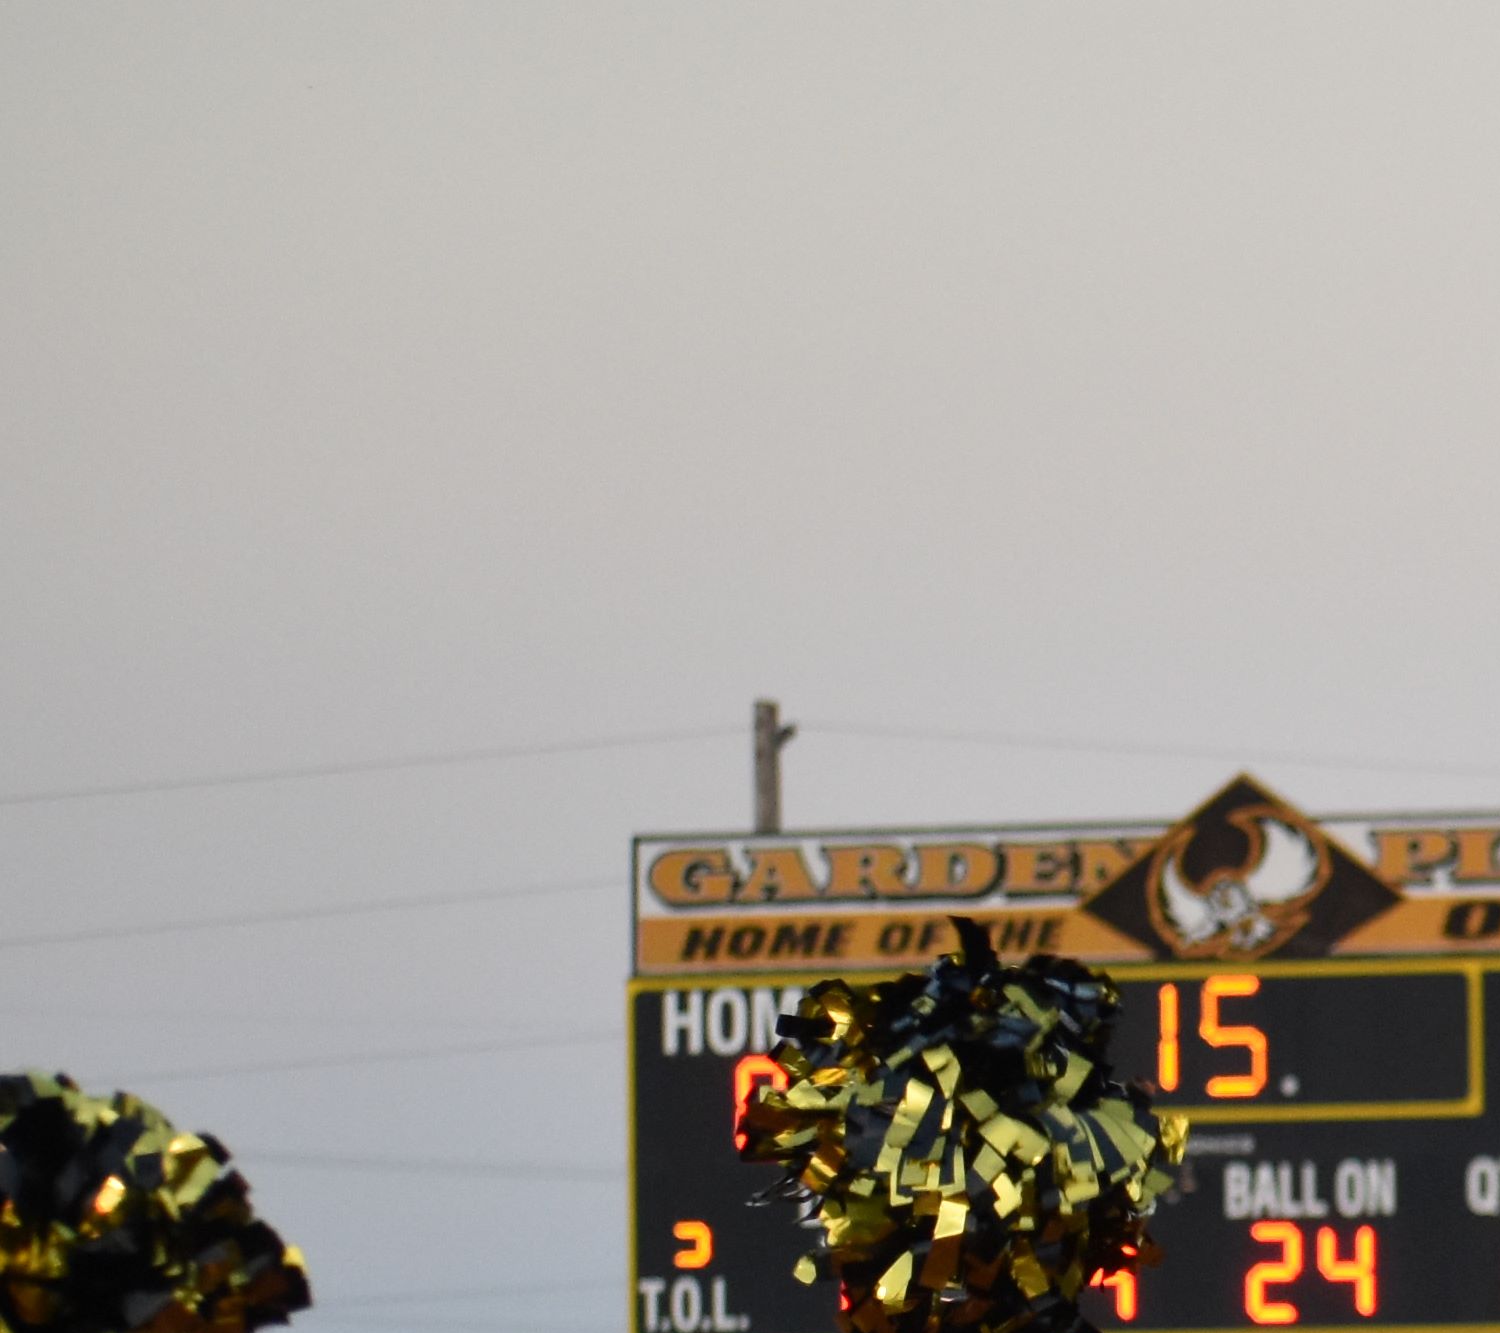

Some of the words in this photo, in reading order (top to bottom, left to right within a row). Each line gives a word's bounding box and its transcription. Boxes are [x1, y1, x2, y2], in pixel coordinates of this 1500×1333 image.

[648, 840, 1157, 910] GARDEN
[681, 921, 854, 963] HOME
[876, 918, 947, 953] OF
[975, 914, 1064, 952] HE
[661, 986, 800, 1057] HOM
[1223, 1160, 1329, 1219] BALL
[1334, 1156, 1398, 1218] ON
[1244, 1219, 1377, 1325] 24
